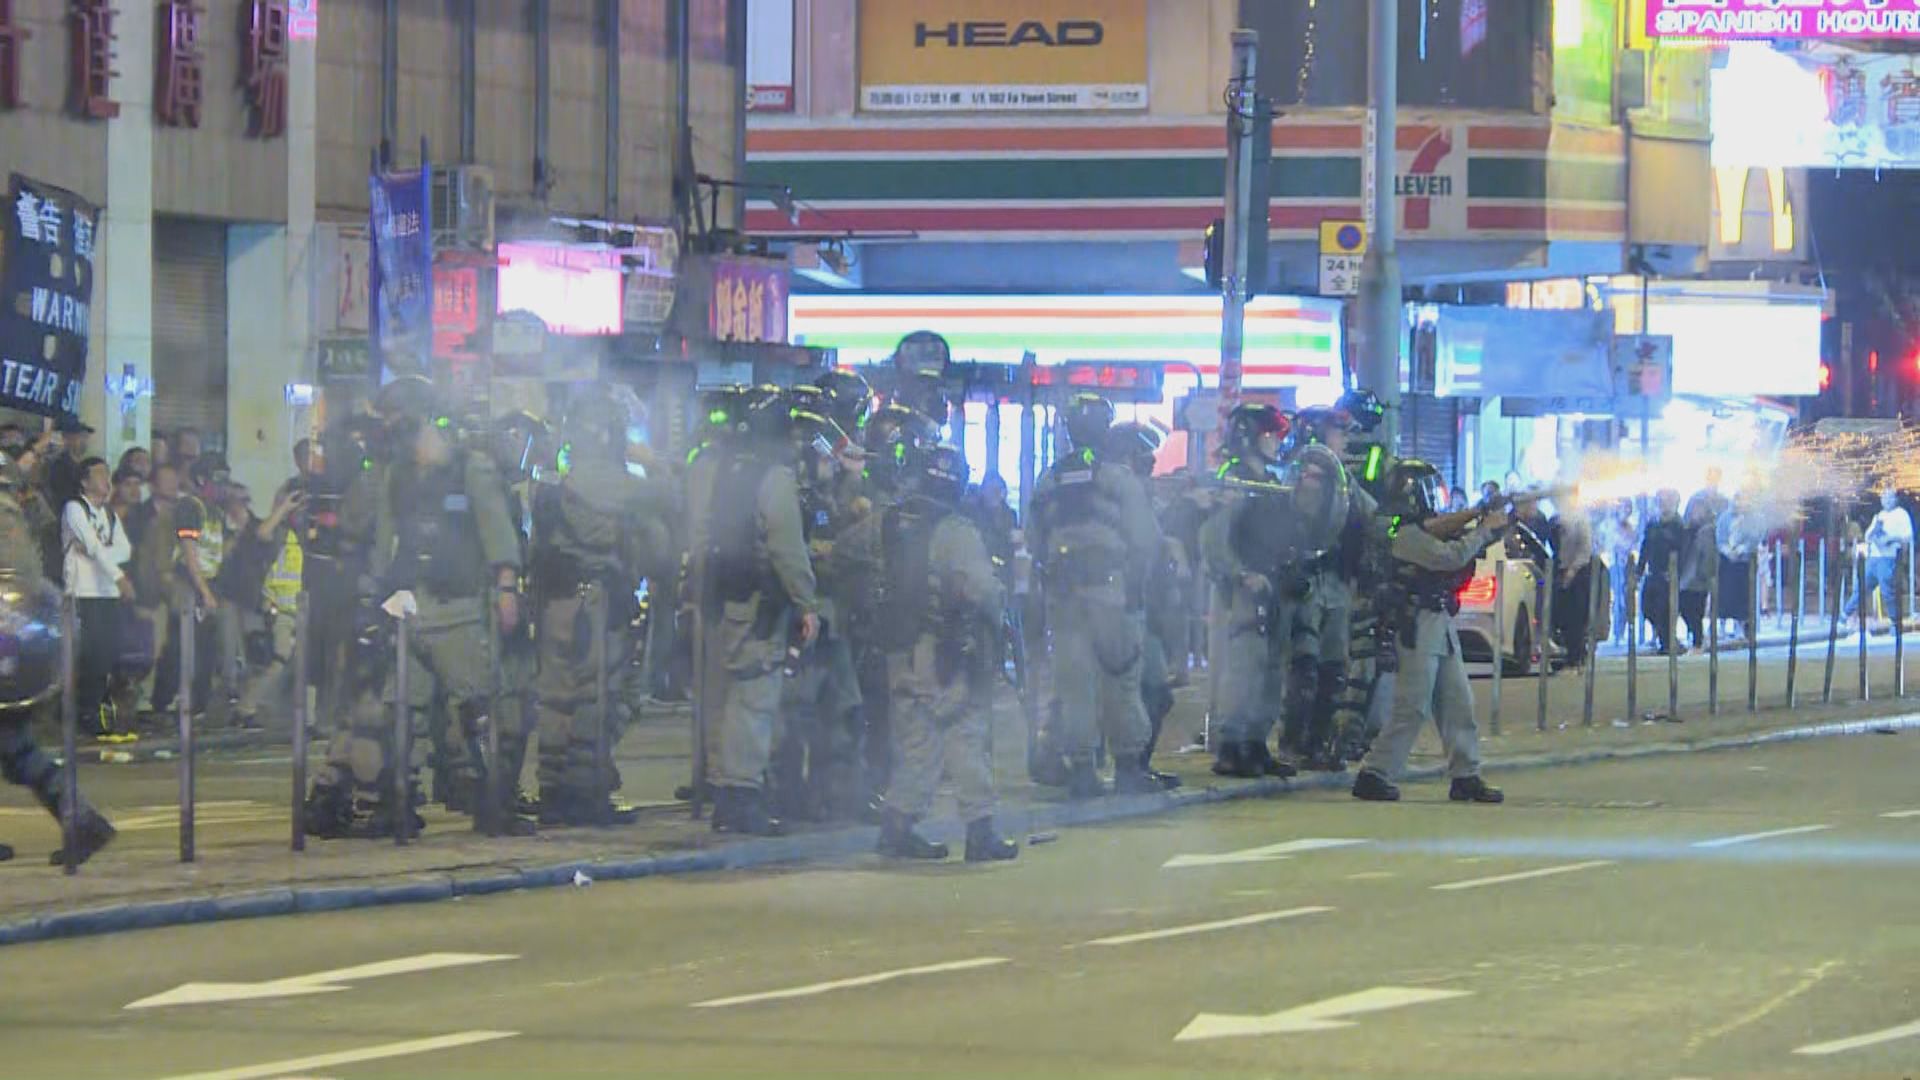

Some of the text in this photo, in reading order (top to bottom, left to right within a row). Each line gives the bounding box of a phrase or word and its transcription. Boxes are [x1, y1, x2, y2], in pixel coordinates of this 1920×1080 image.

[1656, 9, 1801, 33] SPANISH
[915, 21, 1104, 47] HEAD
[1047, 92, 1077, 104] Street
[1327, 259, 1345, 271] 24
[3, 359, 59, 405] TEAR
